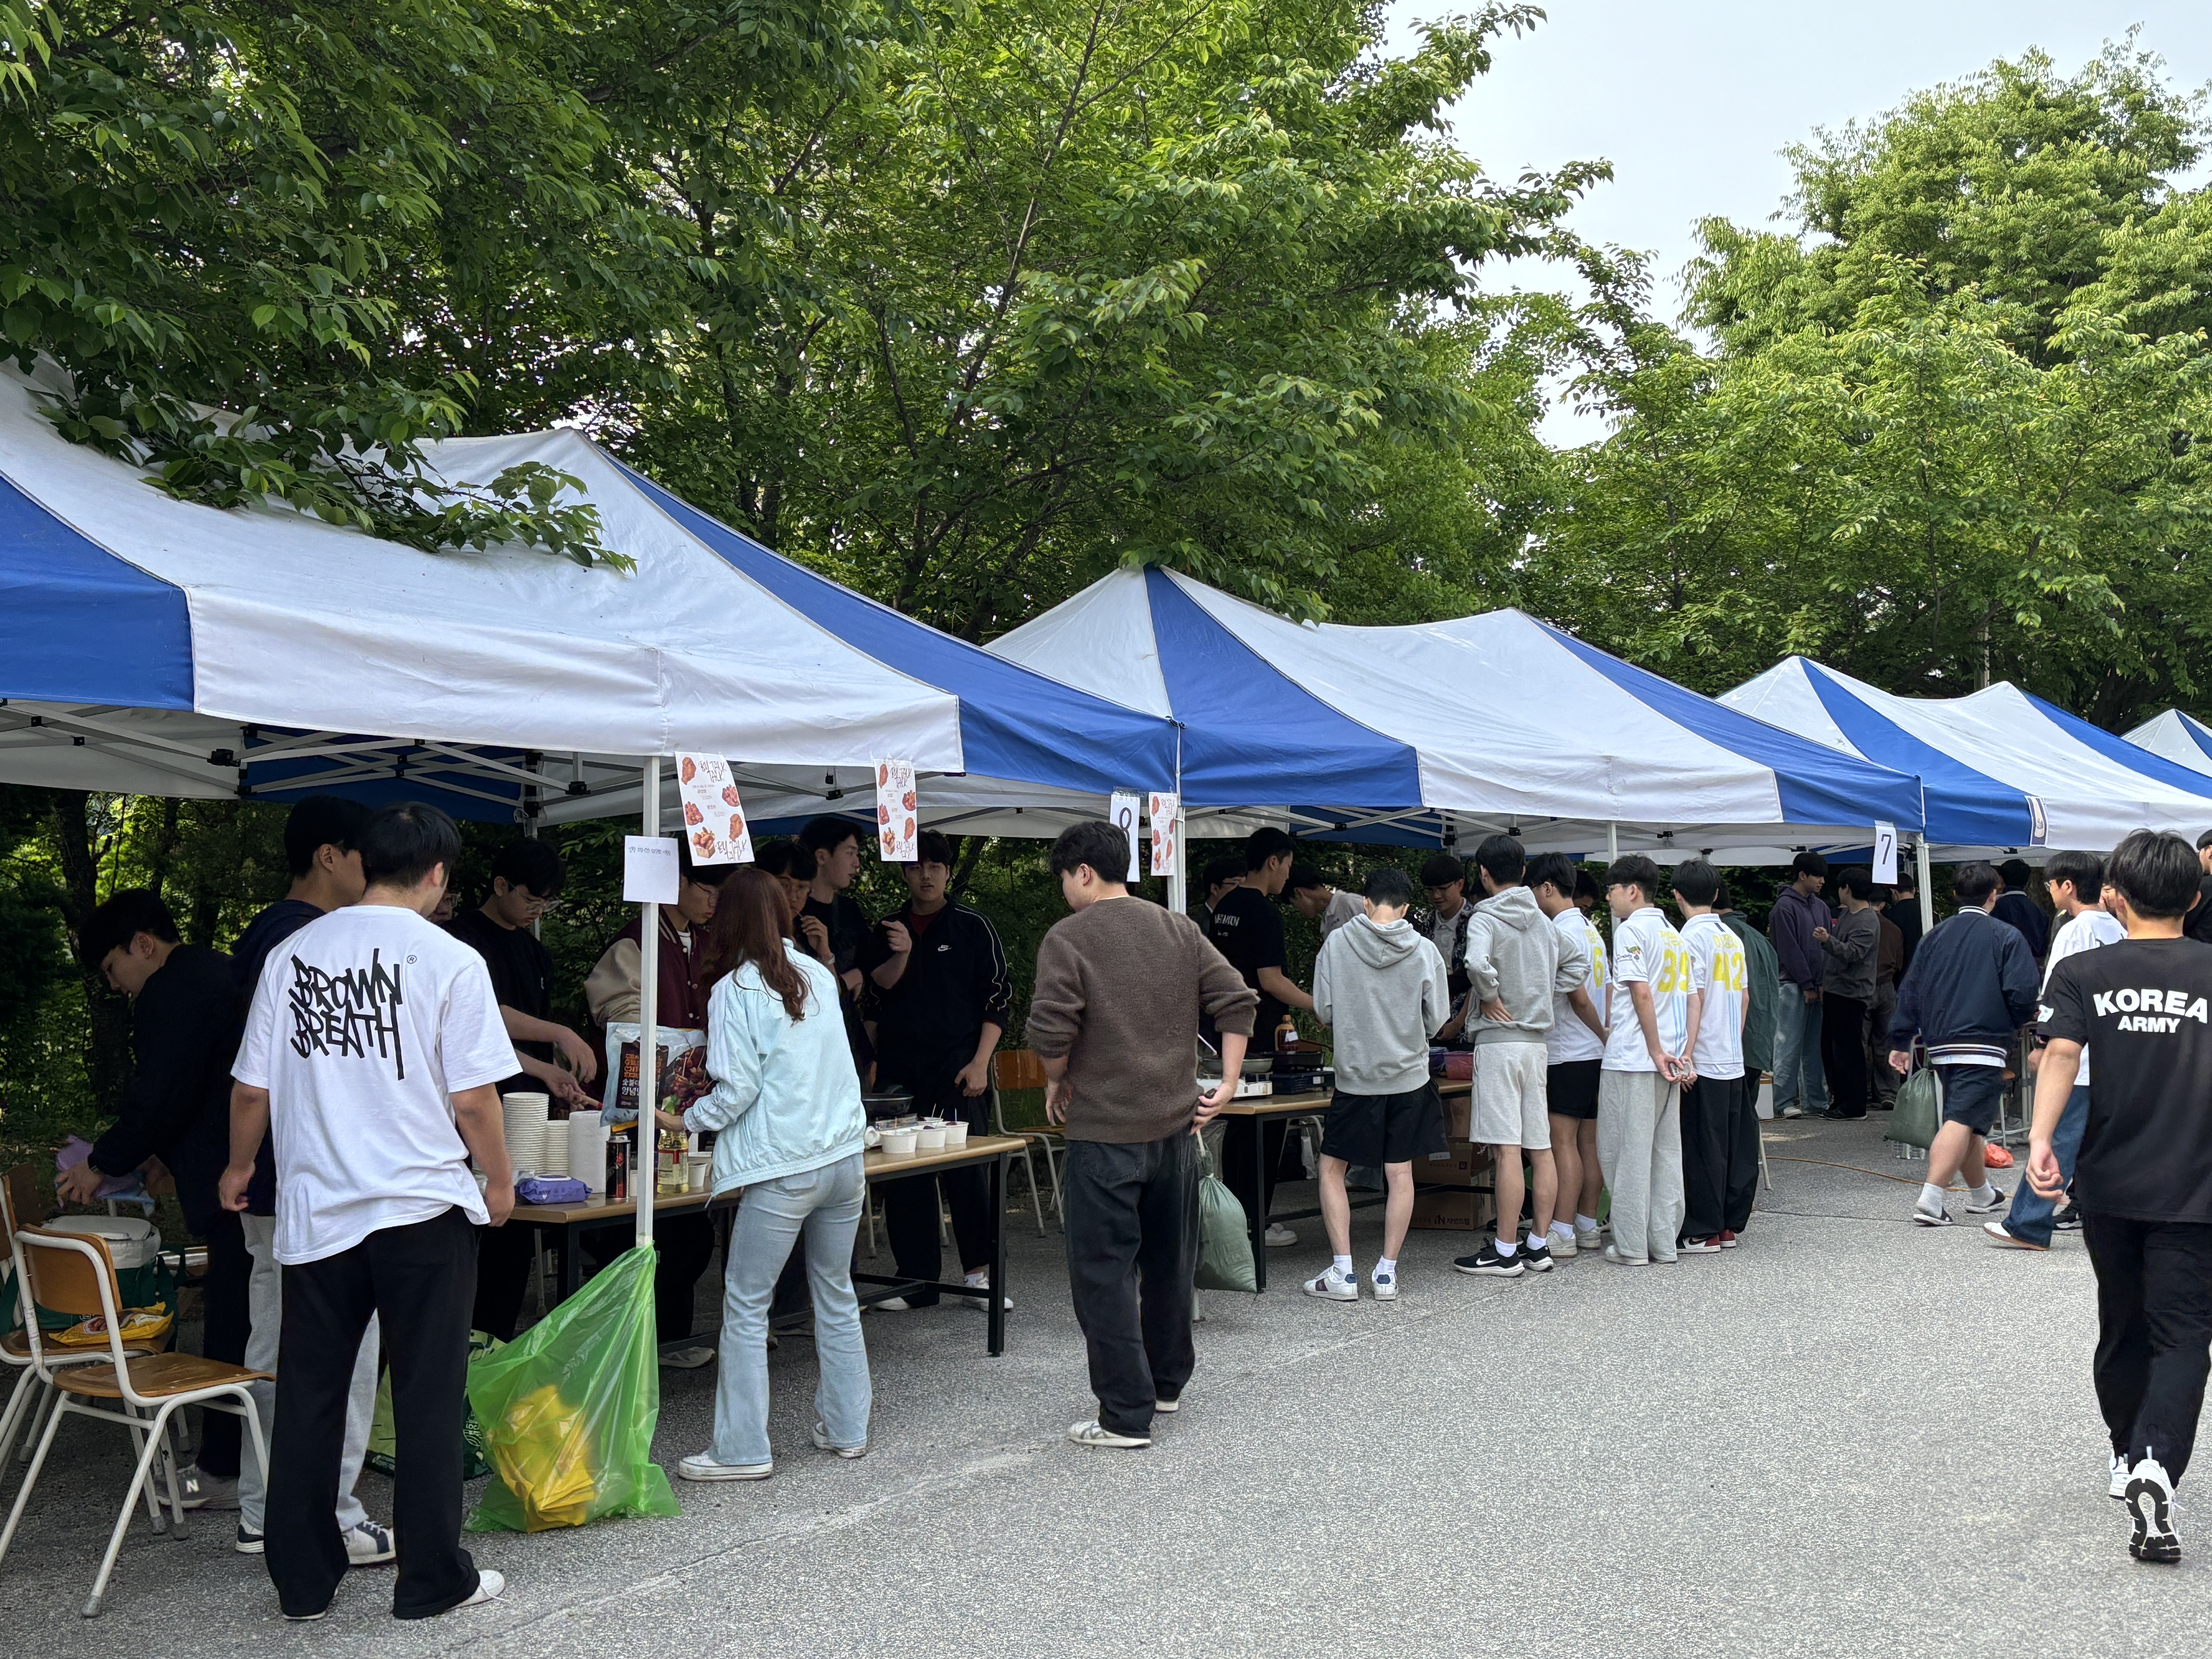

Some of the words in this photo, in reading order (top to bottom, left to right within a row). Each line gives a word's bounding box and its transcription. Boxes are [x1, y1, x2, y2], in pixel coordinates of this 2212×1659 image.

[1881, 833, 1891, 865] 7
[289, 948, 403, 1012] BROWN
[1593, 946, 1604, 988] 6
[1712, 952, 1743, 991] 42
[2093, 988, 2208, 1024] KOREA
[2117, 1016, 2181, 1033] ARMY
[289, 994, 405, 1080] BREATH
[186, 1479, 199, 1493] N
